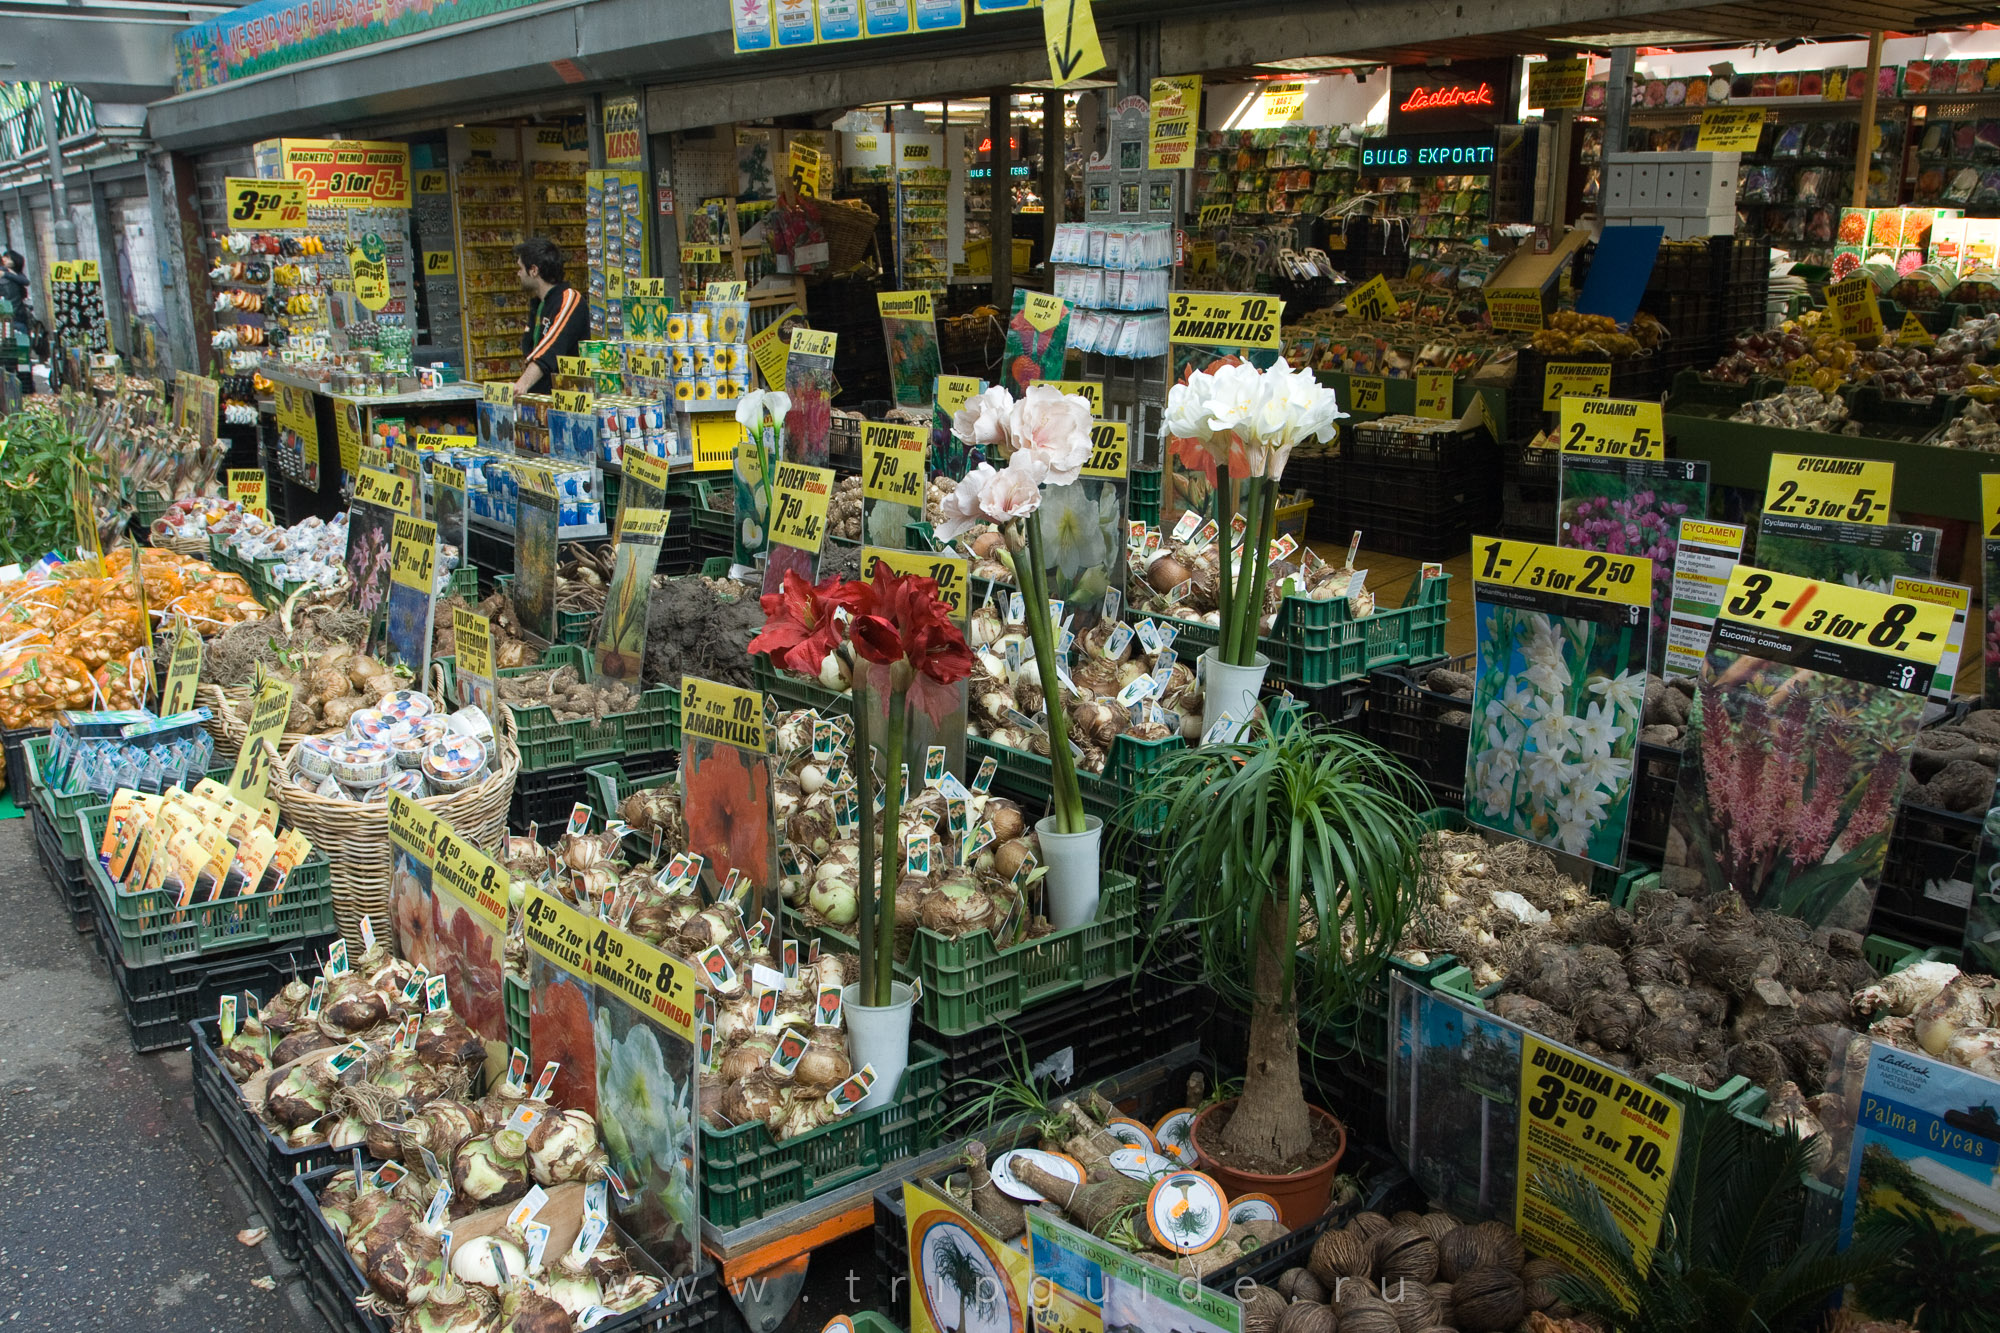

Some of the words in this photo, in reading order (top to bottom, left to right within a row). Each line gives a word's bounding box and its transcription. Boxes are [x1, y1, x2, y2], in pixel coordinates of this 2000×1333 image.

[229, 27, 247, 50] WE
[247, 17, 276, 46] SEND
[278, 9, 309, 38] YOUR
[312, 0, 353, 27] BULBS
[1400, 82, 1493, 112] Laddrak
[1155, 122, 1190, 137] FEMALE
[289, 152, 334, 163] MAGNETIC
[337, 153, 363, 163] MEMO
[367, 152, 404, 164] HOLDERS
[904, 145, 929, 158] SEEDS
[1154, 142, 1189, 154] CANNABIS
[1362, 149, 1407, 165] BULB
[1160, 154, 1180, 165] SEEDS
[331, 173, 345, 193] 3
[347, 173, 372, 193] for
[1358, 286, 1376, 306] bags
[1828, 278, 1867, 298] WOODEN
[1837, 291, 1866, 306] SHOES
[913, 295, 931, 314] 10.-
[1033, 298, 1050, 308] CALLA
[1173, 296, 1198, 317] 3.-
[1203, 308, 1211, 318] 4
[1212, 307, 1231, 319] for
[1240, 299, 1277, 321] 10.-
[1492, 303, 1540, 312] POST-ORDER
[751, 330, 776, 350] LOTUS
[1173, 320, 1275, 342] AMARYLLIS
[1548, 365, 1610, 376] STRAWBERRIES
[949, 382, 965, 392] CALLA
[1352, 379, 1361, 388] 50
[1362, 380, 1382, 390] Tulips
[1436, 397, 1446, 411] 5
[1582, 402, 1638, 417] CYCLAMEN
[865, 427, 900, 449] PIOEN
[900, 430, 915, 441] roos
[1565, 422, 1595, 452] 2.-
[1595, 438, 1606, 453] 3
[1606, 439, 1628, 455] for
[1629, 428, 1661, 458] 5.-
[232, 471, 264, 481] WOODEN
[448, 469, 456, 484] for
[868, 452, 899, 490] 7.50
[1797, 457, 1865, 476] CYCLAMEN
[236, 482, 262, 493] SHOES
[776, 467, 807, 490] PIOEN
[806, 472, 820, 483] roos
[378, 489, 391, 503] for
[1768, 480, 1806, 513] 2.-
[1805, 499, 1819, 515] 3
[1820, 499, 1846, 518] for
[1846, 489, 1886, 522] 5.-
[773, 493, 802, 533] 7.50
[394, 519, 412, 540] BELLA
[412, 525, 436, 547] DONNA
[1683, 523, 1736, 538] CYCLAMEN
[1764, 518, 1798, 529] Cyclamen
[1799, 522, 1822, 532] Album
[1531, 568, 1545, 586] 3
[1545, 568, 1576, 590] for
[1576, 555, 1635, 596] 2.50
[1675, 572, 1708, 582] CYCLAMEN
[1895, 580, 1960, 599] CYCLAMEN
[455, 610, 474, 630] TULIPS
[473, 620, 486, 634] from
[1804, 610, 1827, 632] 3
[1828, 612, 1868, 640] for
[1867, 603, 1938, 652] 8.-
[456, 627, 488, 652] AMSTERDAM
[1719, 628, 1755, 643] Eucomis
[1757, 637, 1793, 652] comosa
[256, 690, 288, 719] CANNABIS
[683, 682, 702, 709] 3.-
[712, 699, 726, 716] for
[733, 695, 761, 724] 10.-
[250, 709, 287, 737] Starterskit
[684, 713, 761, 748] AMARYLLIS
[390, 796, 410, 820] 4.50
[415, 820, 428, 838] for
[389, 820, 426, 854] AMARYLLIS
[436, 835, 461, 862] 4.50
[465, 863, 480, 882] for
[480, 865, 501, 895] 8.-
[434, 860, 478, 900] AMARYLLIS
[475, 890, 507, 920] JUMBO
[526, 897, 557, 927] 4.50
[557, 924, 567, 939] 2
[566, 928, 584, 949] for
[527, 925, 582, 968] AMARYLLIS
[593, 929, 623, 962] 4.50
[625, 958, 634, 974] 2
[634, 963, 653, 984] for
[655, 962, 683, 998] 8.-
[594, 960, 652, 1005] AMARYLLIS
[651, 994, 692, 1029] JUMBO
[1877, 1063, 1928, 1085] MULTICULTURA
[1878, 1054, 1931, 1079] Laddrak
[1531, 1046, 1614, 1098] BUDDHA
[1613, 1083, 1671, 1126] PALM
[1880, 1072, 1921, 1089] AMSTERDAM
[1883, 1079, 1916, 1094] HOLLAND
[1528, 1074, 1598, 1129] 3.50
[1620, 1106, 1671, 1140] Bodhi-boom
[1864, 1098, 1917, 1134] Palma
[1929, 1119, 1984, 1157] Cycas
[1582, 1124, 1595, 1141] 3
[1594, 1131, 1622, 1154] for
[1624, 1134, 1666, 1181] 10.-
